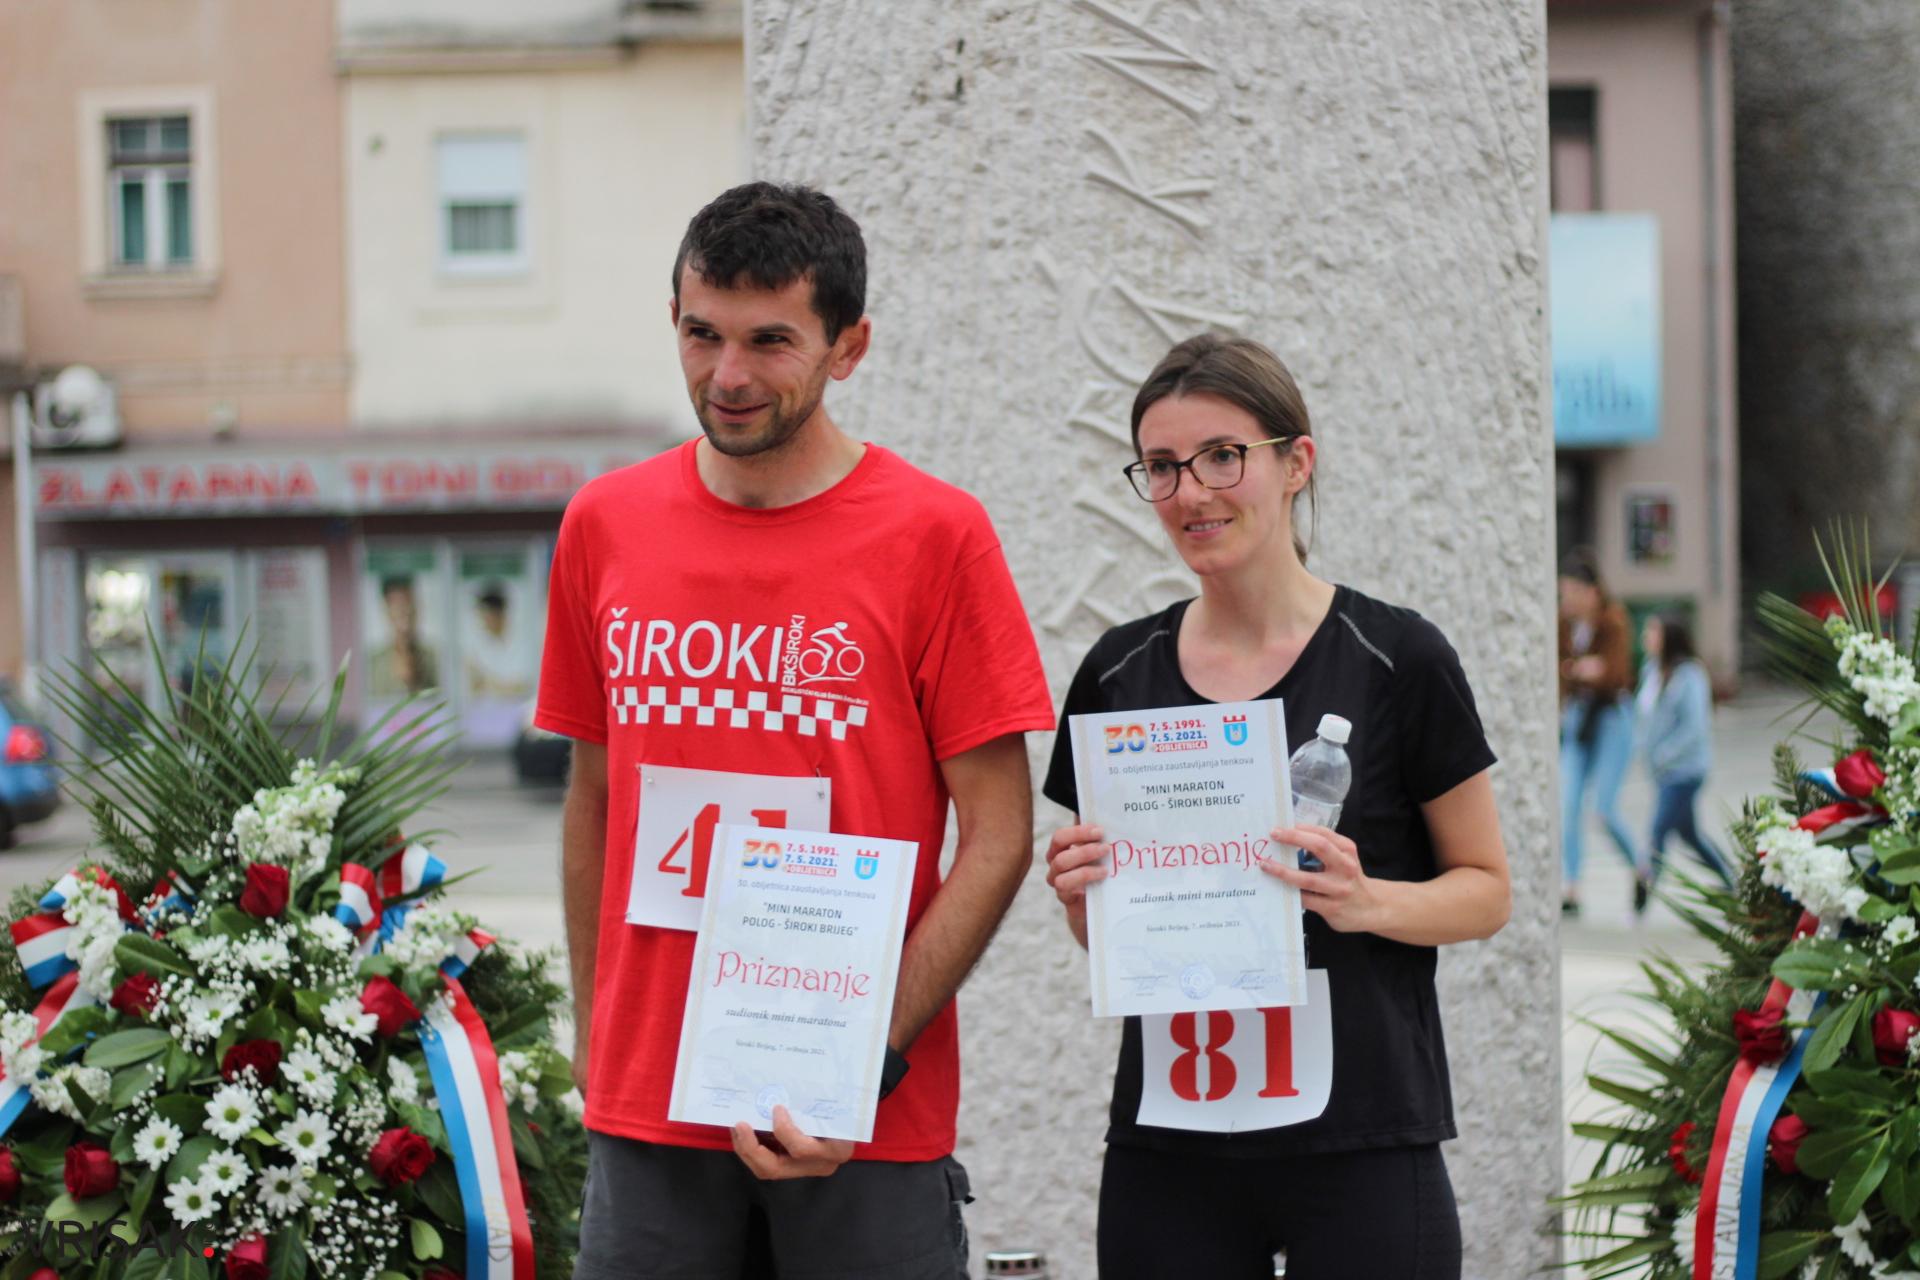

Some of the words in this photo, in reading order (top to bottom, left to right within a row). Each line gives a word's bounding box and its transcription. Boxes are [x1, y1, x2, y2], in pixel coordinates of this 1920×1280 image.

[37, 460, 318, 508] ZLATARNA
[606, 606, 784, 683] ŠIROKI
[1104, 723, 1146, 754] 30
[1221, 756, 1254, 767] tenkova
[1173, 780, 1225, 793] MARATON
[1124, 801, 1159, 812] POLOG
[1168, 797, 1203, 809] ŠIROKI
[657, 803, 787, 898] 4
[741, 840, 781, 869] 30
[1110, 833, 1272, 877] Priznanje
[1129, 891, 1175, 904] sudionik
[1177, 889, 1202, 901] mini
[1204, 888, 1256, 900] maratona
[742, 916, 775, 928] POLOG
[784, 918, 818, 932] ŠIROKI
[793, 905, 842, 919] MARATON
[713, 951, 871, 1001] Priznanje
[725, 1007, 769, 1021] sudionik
[771, 1011, 796, 1023] mini
[797, 1016, 846, 1028] maratona
[1169, 1006, 1300, 1101] 81
